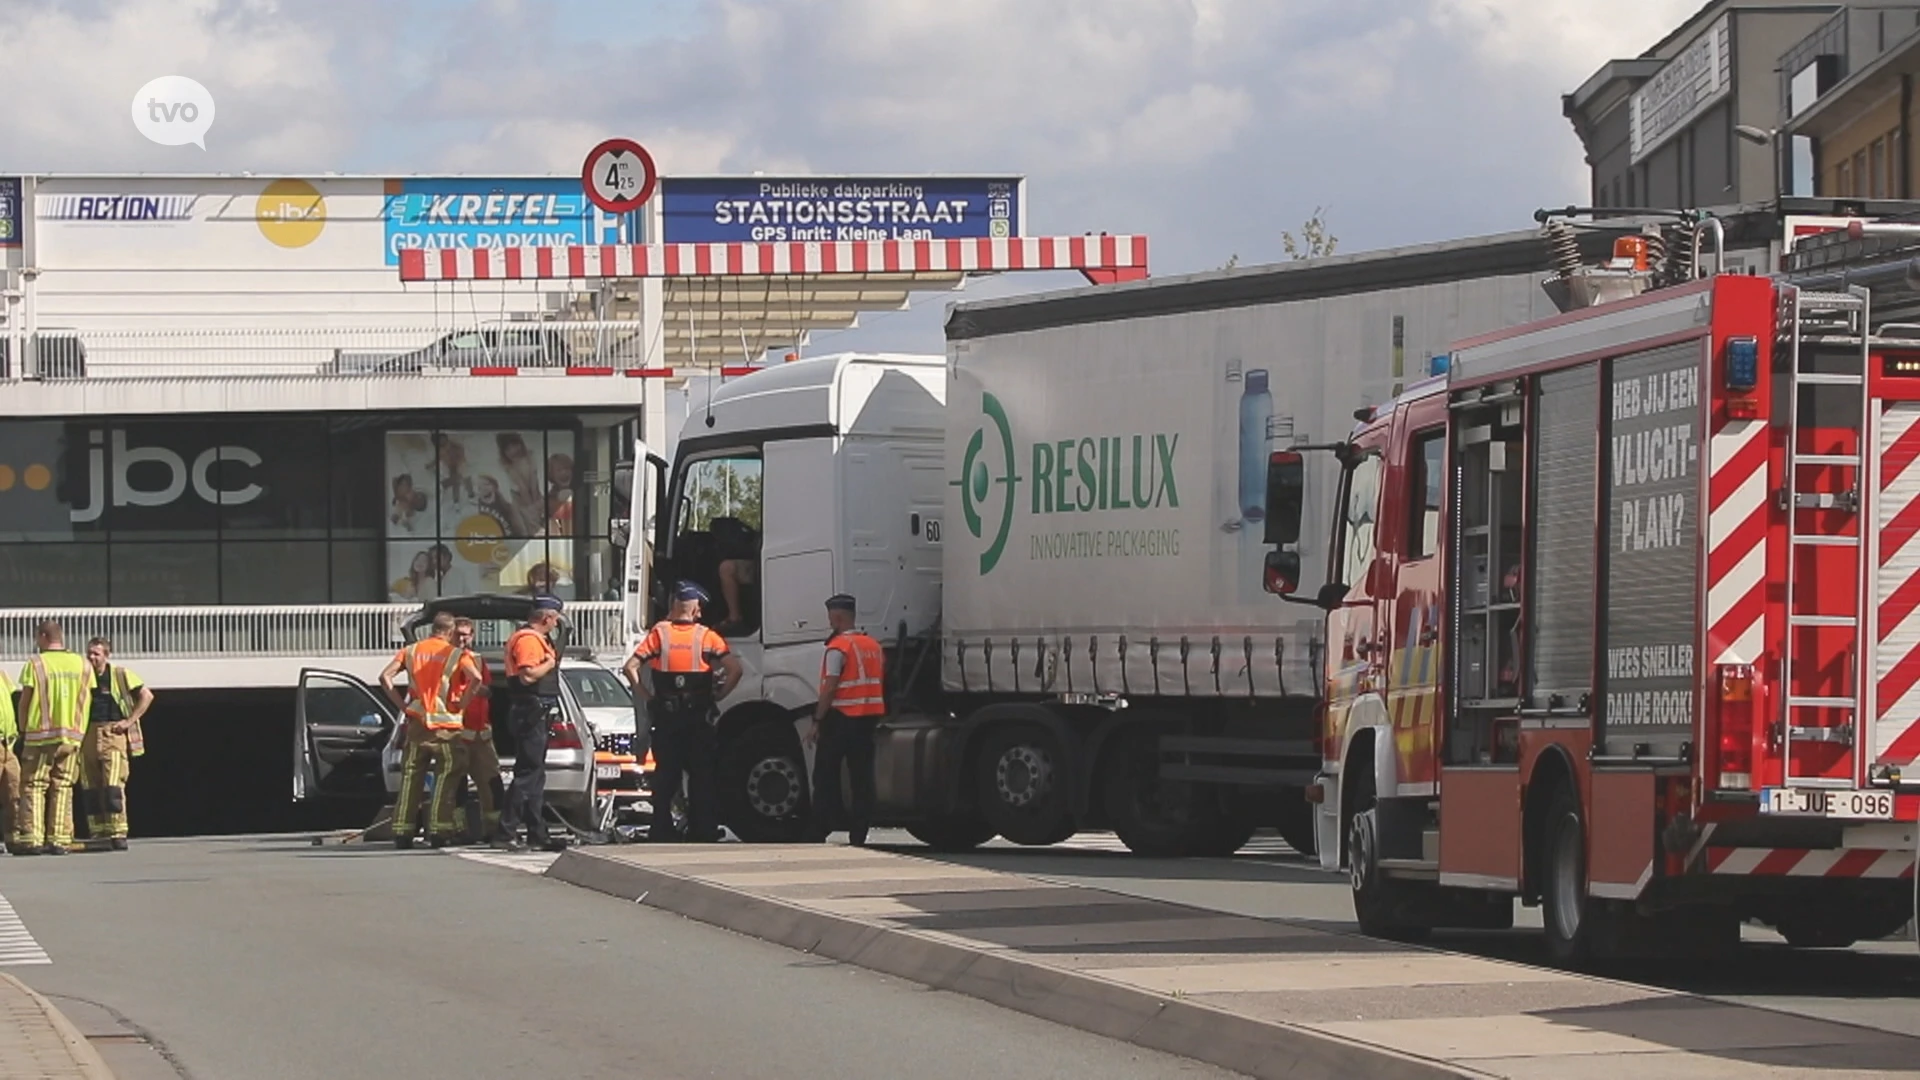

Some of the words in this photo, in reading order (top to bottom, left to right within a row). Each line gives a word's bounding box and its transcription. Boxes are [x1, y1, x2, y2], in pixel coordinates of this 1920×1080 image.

[605, 163, 619, 190] 4
[620, 177, 635, 190] 25
[759, 183, 828, 198] Publieke
[833, 183, 923, 200] dakparking
[78, 197, 160, 220] ACTION
[714, 201, 968, 224] STATIONSSTRAAT
[390, 232, 468, 256] GRATIS
[477, 232, 576, 249] PARKING
[751, 227, 787, 241] GPS
[792, 227, 832, 241] inrit:
[836, 227, 887, 241] Kleine
[893, 227, 932, 240] Laan
[1612, 379, 1641, 420] HEB
[1643, 373, 1668, 415] JIJ
[1669, 366, 1698, 410] EEN
[1612, 424, 1697, 487] VLUCHT-
[70, 429, 263, 522] jbc
[1031, 433, 1179, 514] RESILUX
[926, 520, 941, 542] 60
[1621, 493, 1685, 552] PLAN?
[1030, 530, 1103, 560] INNOVATIVE
[1107, 529, 1180, 557] PACKAGING
[1608, 647, 1641, 679] WEES
[1642, 644, 1695, 678] SNELLER
[1607, 693, 1633, 725] DAN
[1634, 691, 1652, 724] DE
[1652, 690, 1693, 724] ROOK!
